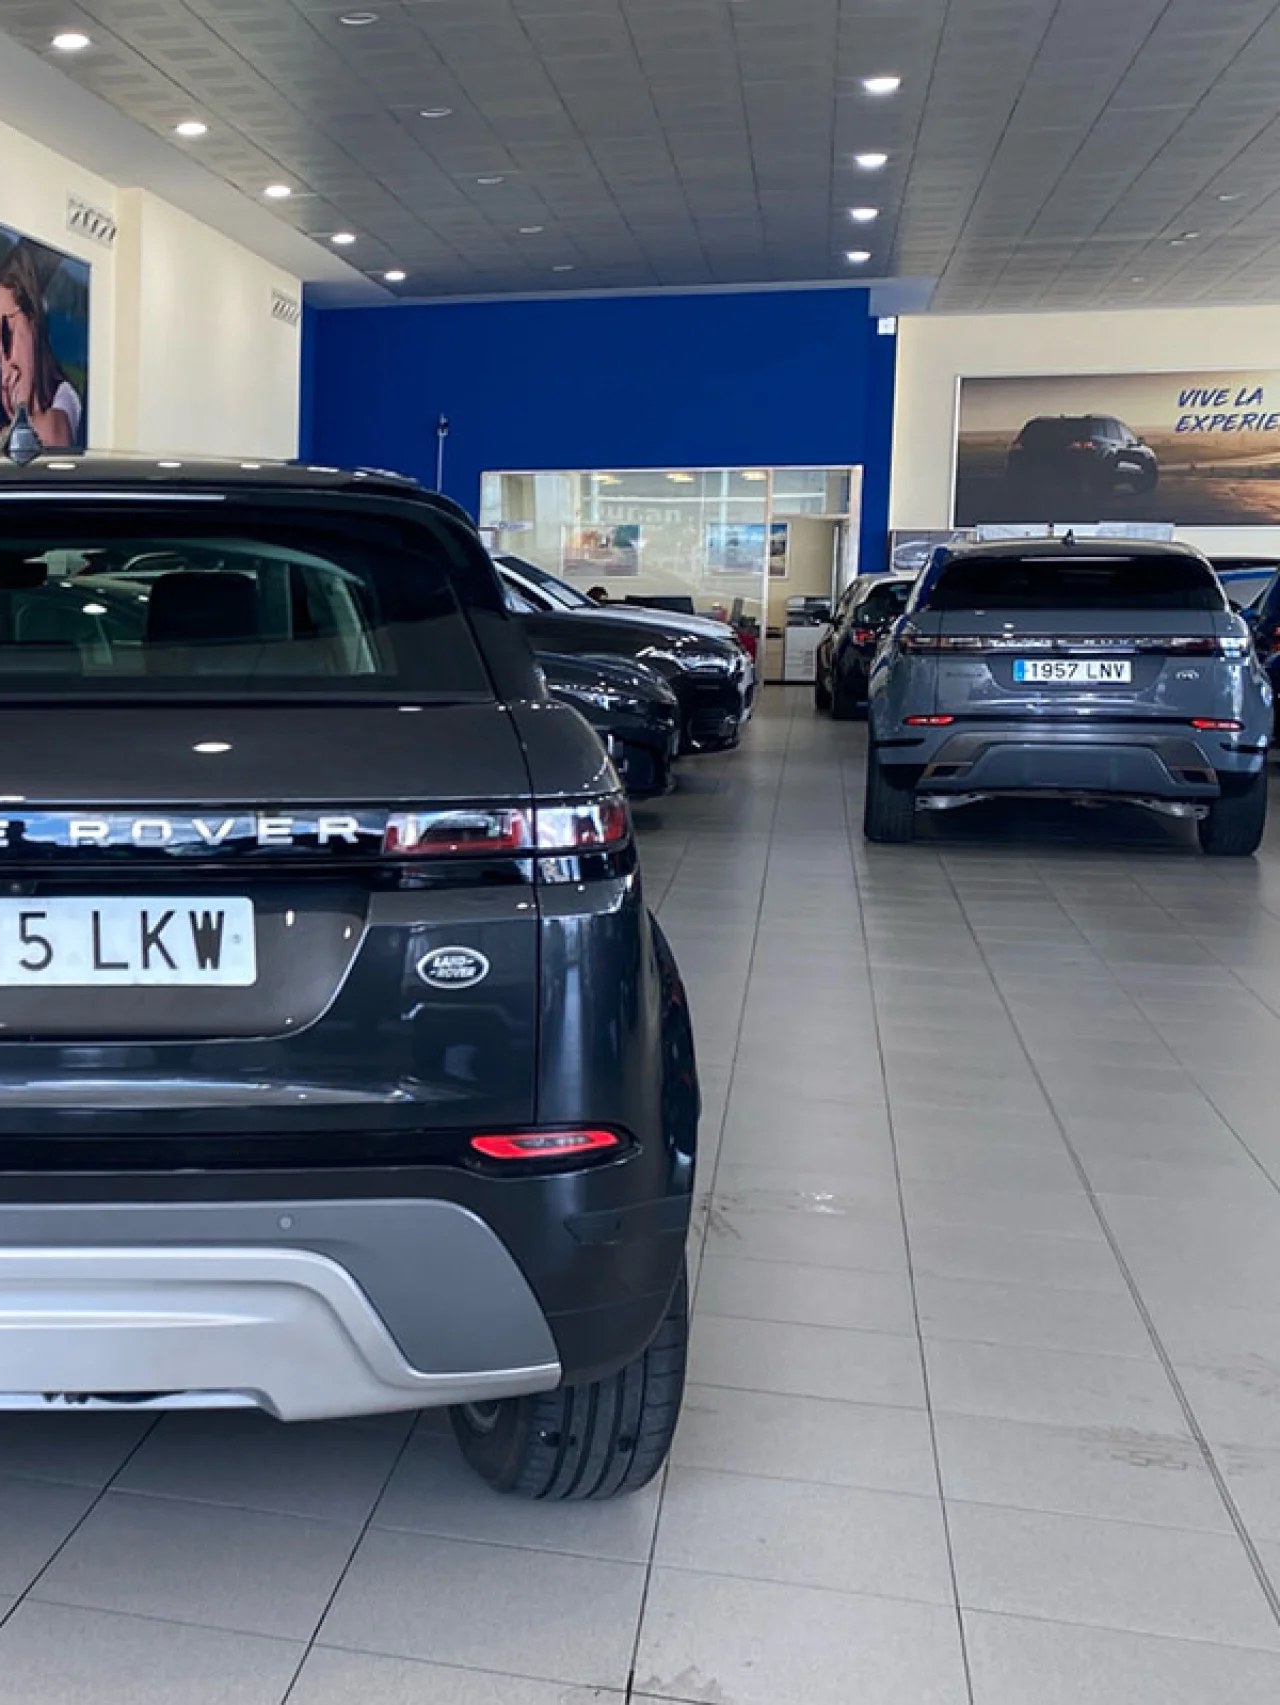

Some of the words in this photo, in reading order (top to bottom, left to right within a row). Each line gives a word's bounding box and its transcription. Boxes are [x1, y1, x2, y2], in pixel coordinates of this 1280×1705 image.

[1178, 388, 1231, 407] VIVE
[1234, 386, 1264, 406] LA
[1032, 663, 1078, 679] 1957
[1087, 663, 1125, 679] LNV
[70, 816, 360, 847] ROVER
[92, 910, 225, 970] LKW
